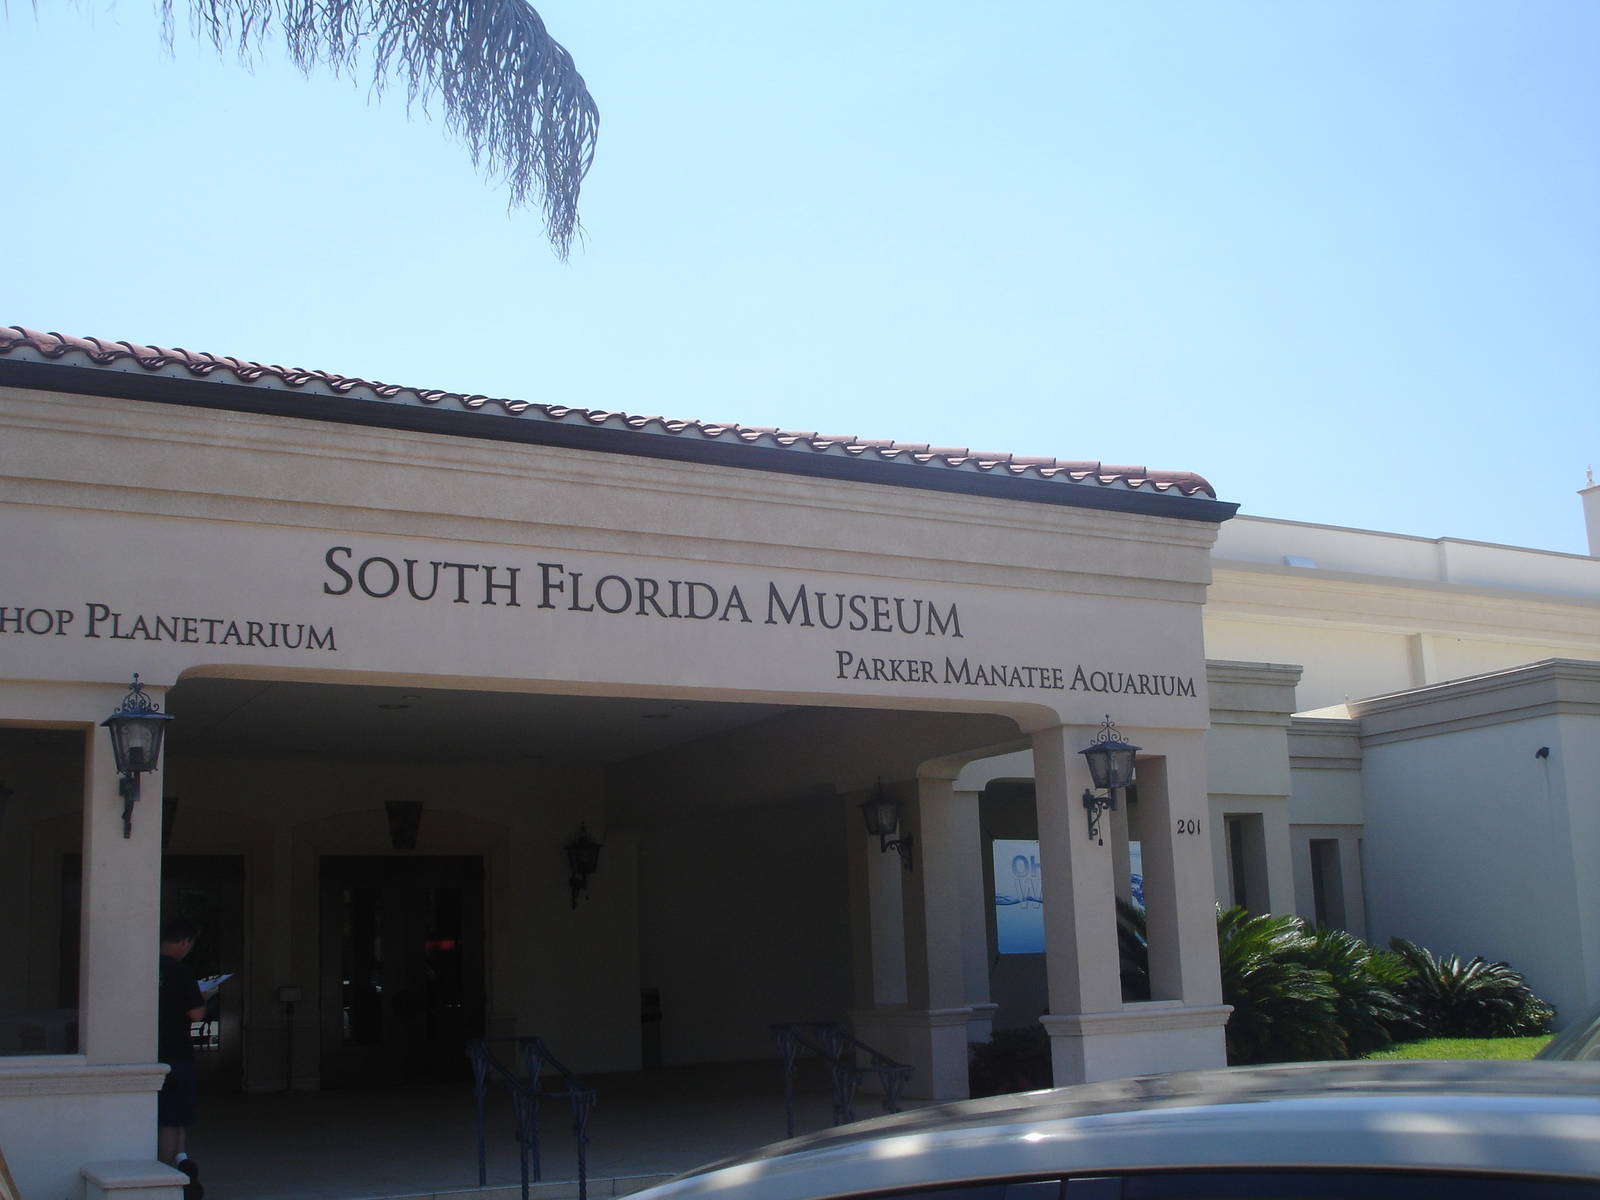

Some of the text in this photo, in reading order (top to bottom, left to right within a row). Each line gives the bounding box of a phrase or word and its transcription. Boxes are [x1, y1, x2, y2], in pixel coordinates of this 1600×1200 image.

[323, 546, 964, 639] SOUTH FLORIDA MUSEUM
[84, 602, 338, 652] PLANETARIUM
[836, 650, 1197, 699] PARKER MANATEE AQUARIUM
[1176, 819, 1201, 836] 201
